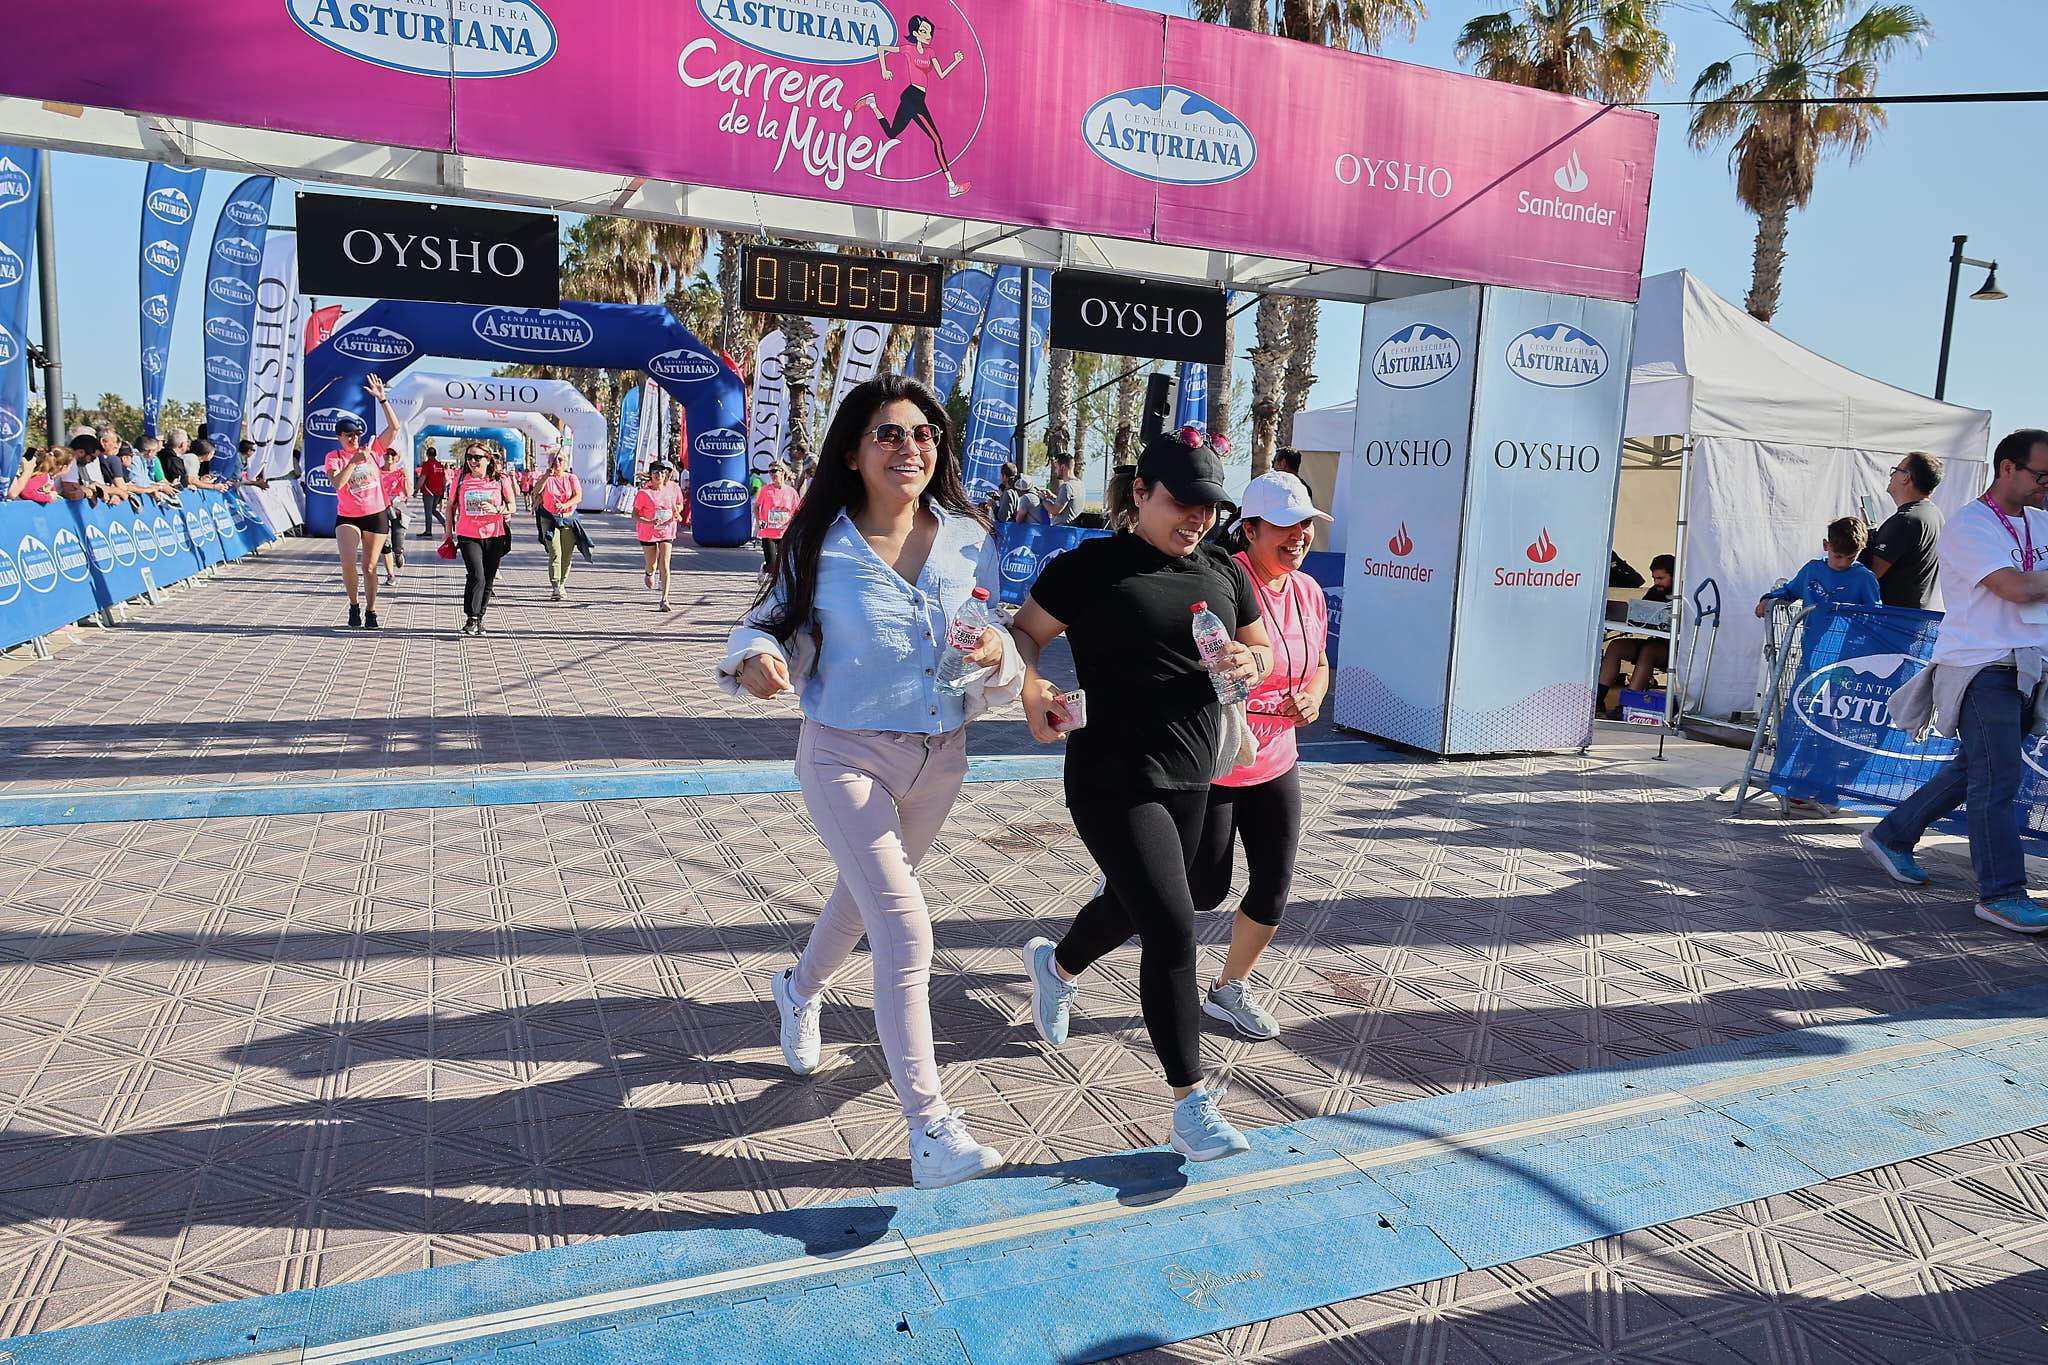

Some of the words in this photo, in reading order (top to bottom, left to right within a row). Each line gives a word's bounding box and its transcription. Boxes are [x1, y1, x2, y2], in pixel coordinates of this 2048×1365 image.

[713, 0, 881, 48] ASTURIANA
[815, 1, 877, 19] LECHERA
[309, 0, 537, 57] ASTURIANA
[678, 38, 844, 112] Carrera
[1096, 111, 1243, 167] ASTURIANA
[1124, 112, 1179, 130] CENTRAL
[1184, 122, 1240, 139] LECHERA
[719, 98, 748, 134] de
[757, 103, 779, 140] la
[773, 106, 902, 191] Mujer
[1334, 153, 1452, 198] OYSHO
[1517, 190, 1616, 226] Santander
[342, 229, 525, 277] OYSHO
[756, 256, 928, 313] 01:05:34
[482, 315, 585, 343] ASTURIANA
[1080, 298, 1203, 337] OYSHO
[339, 337, 408, 354] ASTURIANA
[1512, 344, 1600, 375] ASTURIANA
[252, 277, 287, 447] OYSHO
[655, 360, 715, 374] ASTURIANA
[1377, 351, 1453, 375] ASTURIANA
[445, 381, 538, 404] OYSHO
[699, 437, 746, 450] ASTURIANA
[1366, 439, 1451, 467] OYSHO
[1494, 440, 1600, 473] OYSHO
[700, 489, 746, 501] ASTURIANA
[1364, 558, 1433, 582] Santander
[1494, 567, 1581, 587] Santander
[1845, 680, 1893, 696] CENTR
